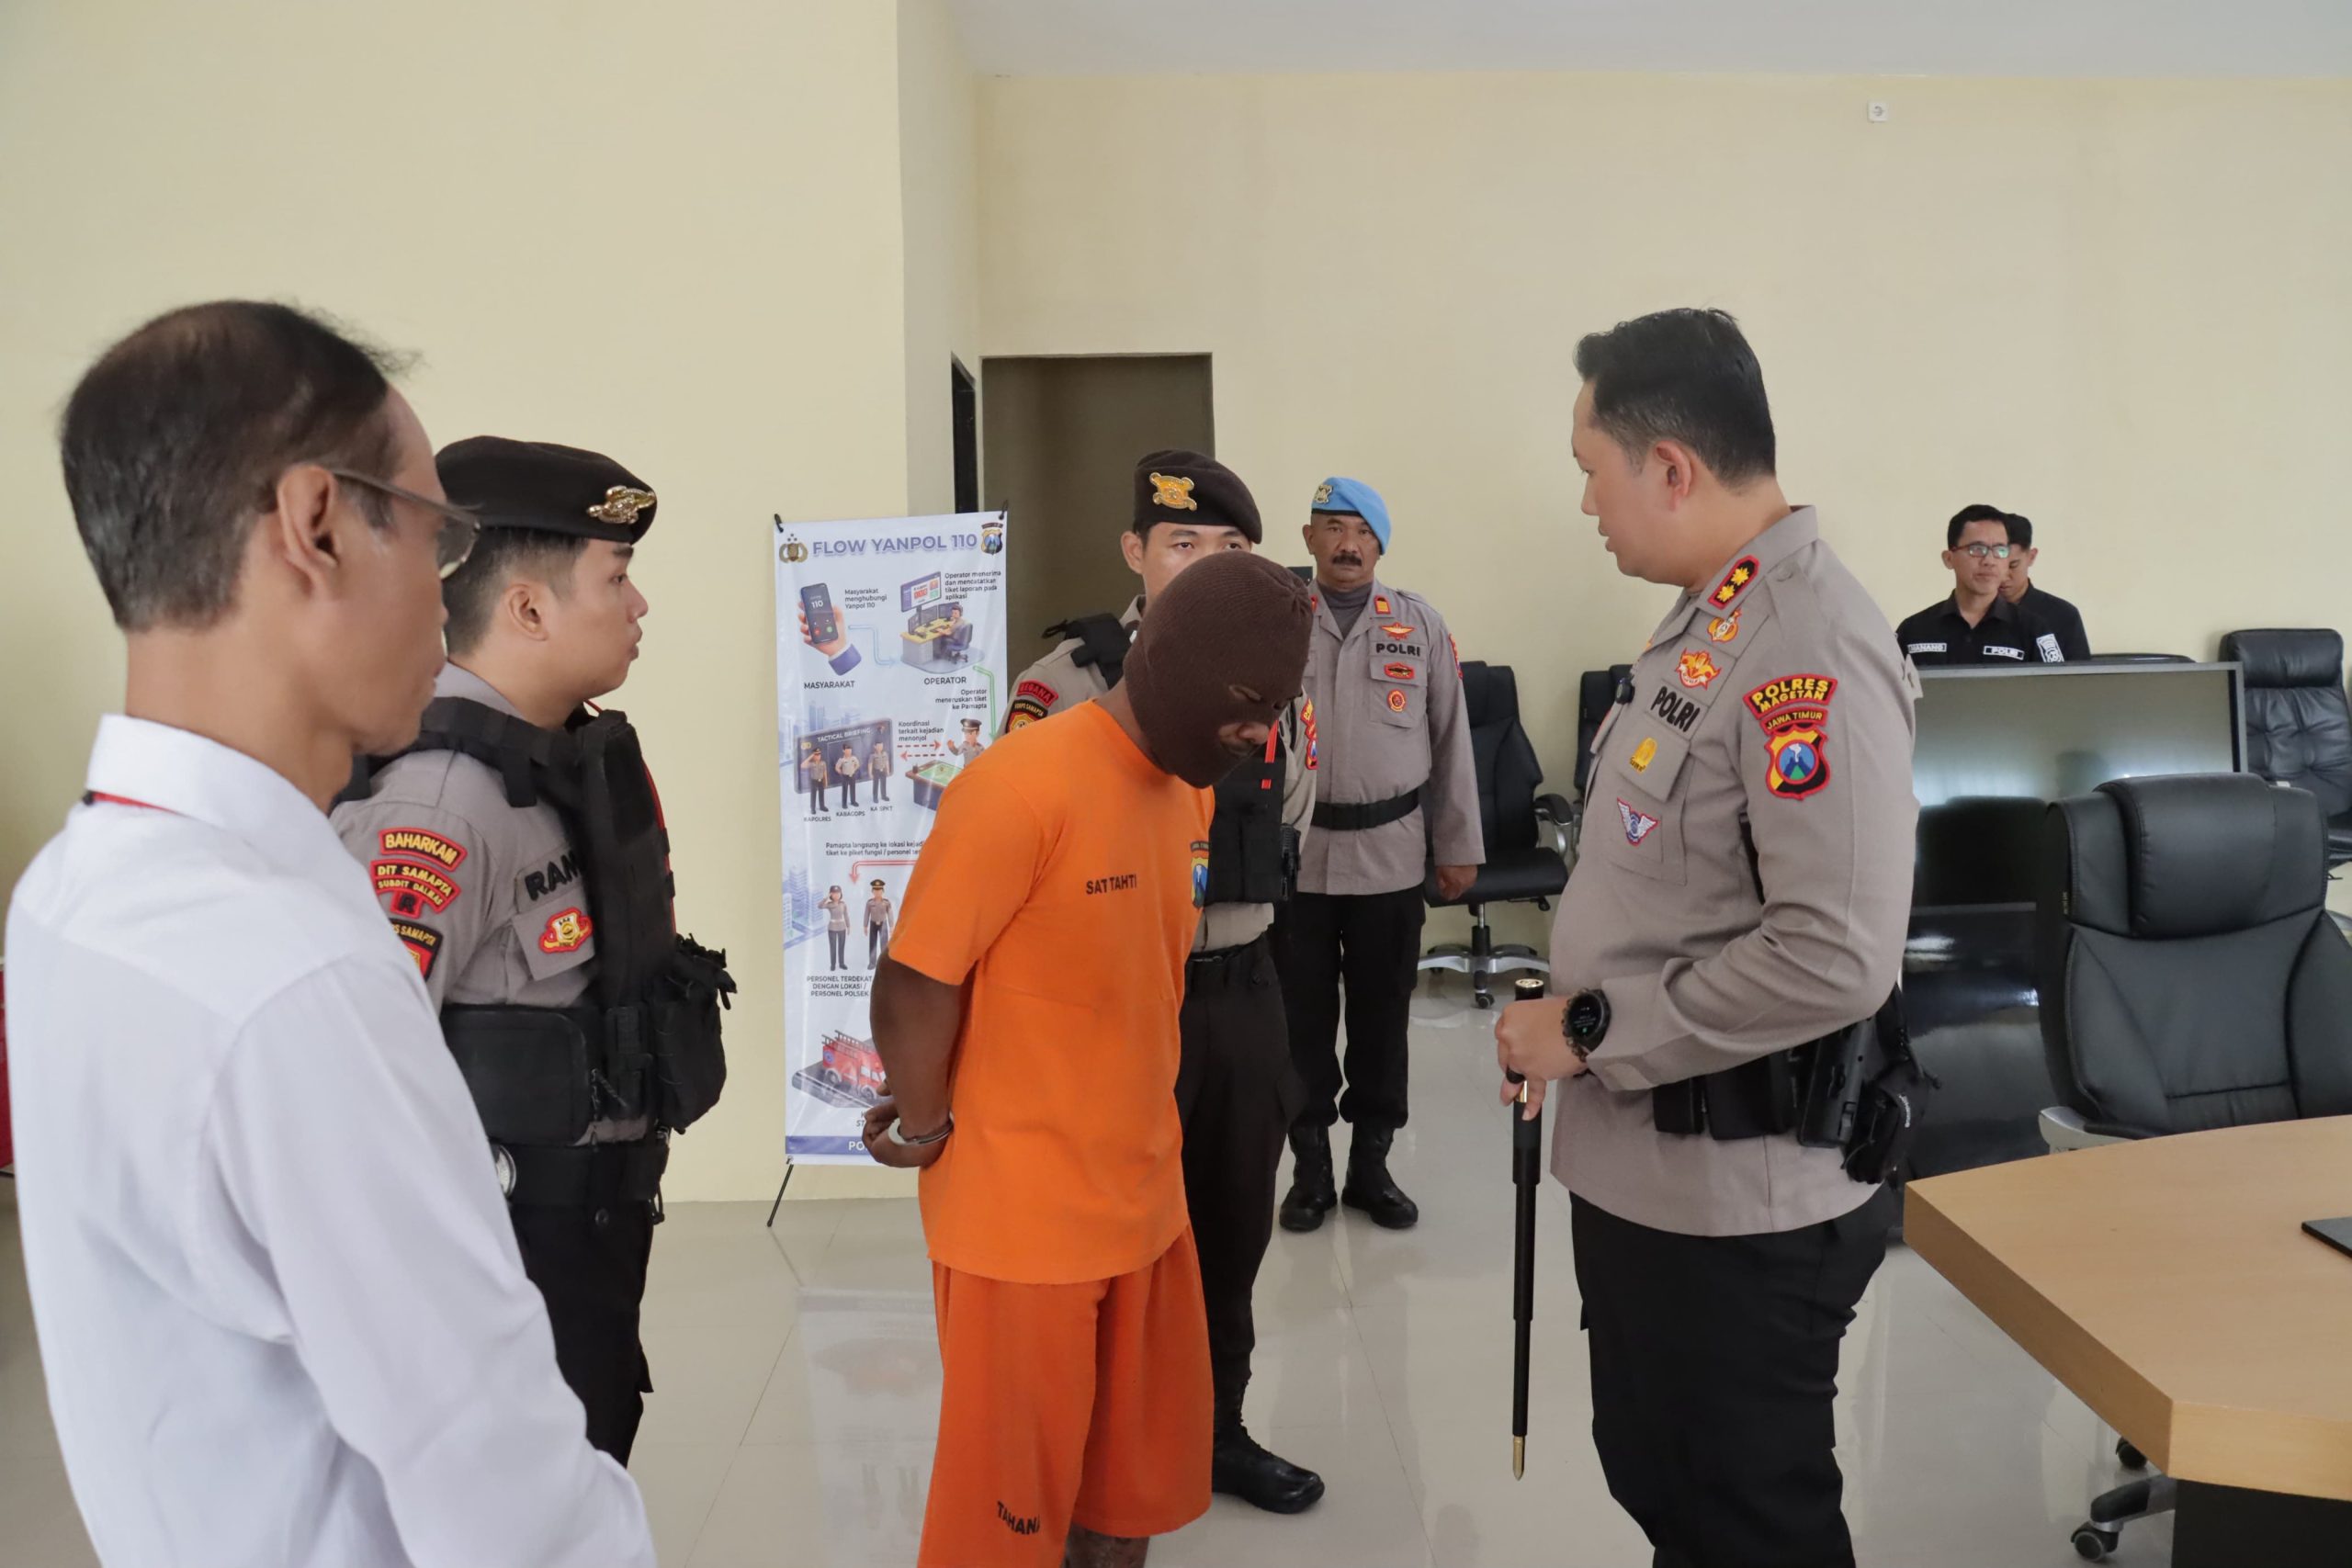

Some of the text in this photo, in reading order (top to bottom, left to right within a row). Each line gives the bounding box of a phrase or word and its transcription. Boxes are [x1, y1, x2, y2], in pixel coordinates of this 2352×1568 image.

[812, 534, 978, 555] FLOW YANPOL 110
[844, 588, 879, 596] Masyarakat
[844, 594, 888, 603] menghubungi
[1376, 643, 1420, 657] POLRI
[804, 681, 855, 689] MASYARAKAT
[923, 676, 967, 685] OPERATOR
[1751, 678, 1829, 705] POLRES
[1650, 685, 1701, 733] POLRI
[1759, 689, 1825, 713] MAGETAN
[1767, 711, 1823, 729] JAWA TIMUR
[817, 733, 843, 743] TACTICAL
[920, 727, 944, 735] kejadian
[385, 832, 458, 864] BAHARKAM
[825, 841, 852, 850] Pamapta
[853, 840, 879, 850] langsung
[906, 840, 924, 848] kejad
[887, 848, 910, 857] personel
[378, 864, 453, 897] DIT SAMAPTA
[1086, 874, 1137, 895] SAT TAHTI
[378, 879, 444, 906] SUBDIT DALMAS
[398, 894, 416, 912] R
[848, 1141, 867, 1151] PO
